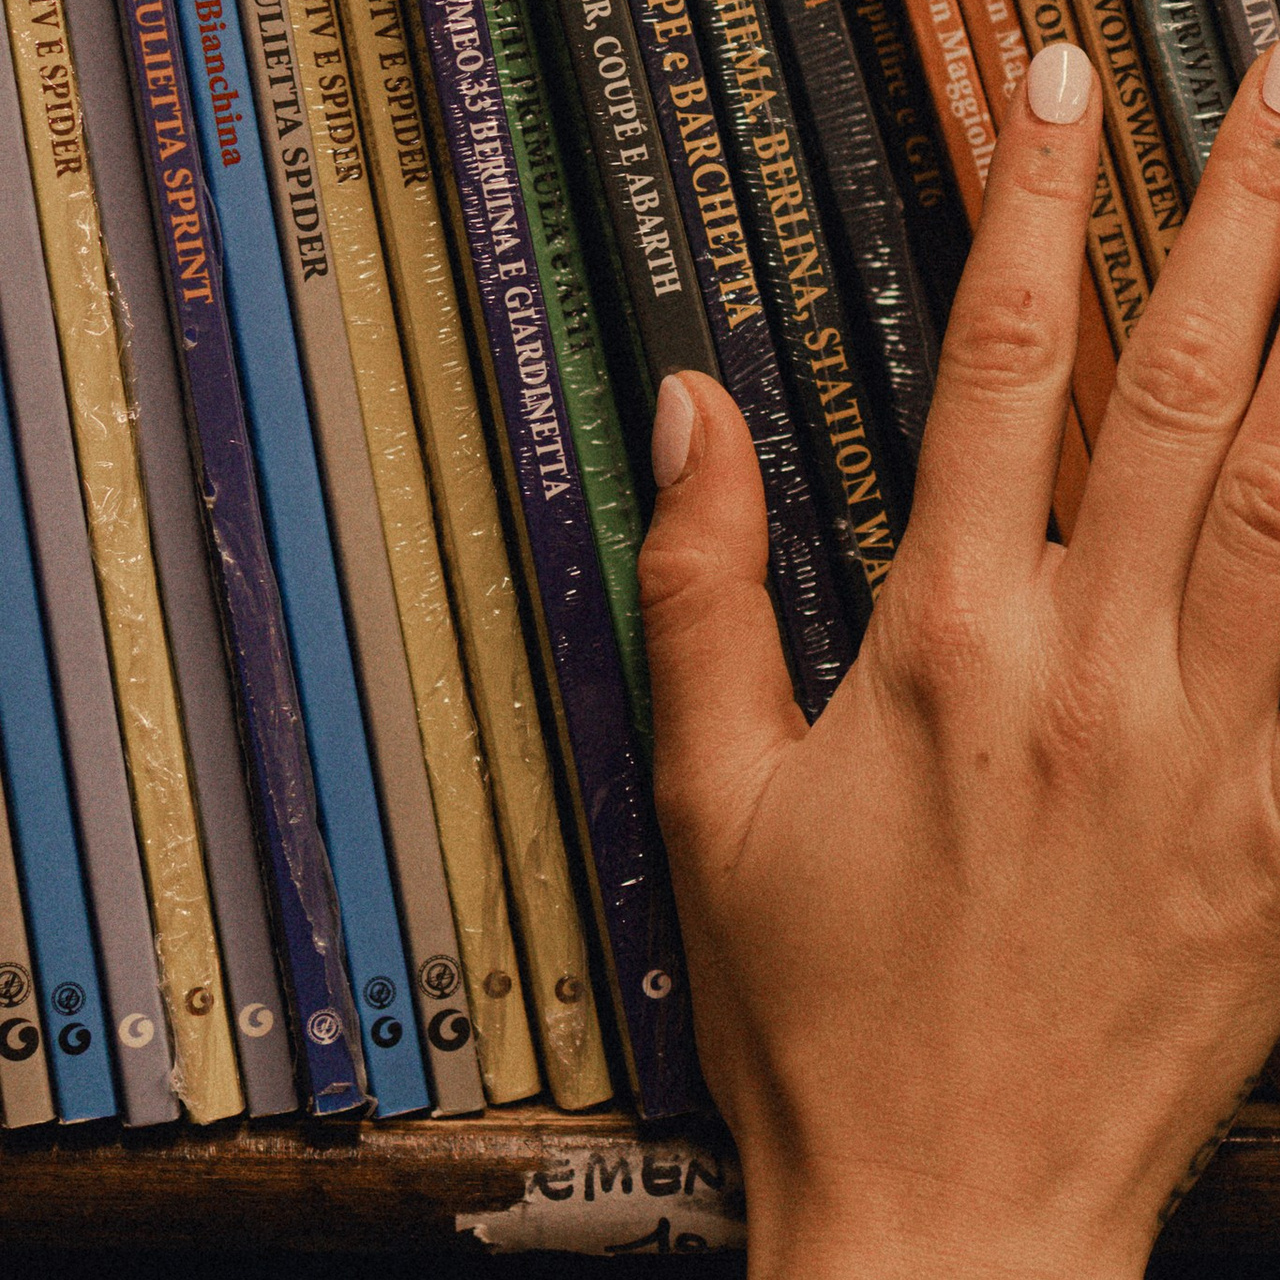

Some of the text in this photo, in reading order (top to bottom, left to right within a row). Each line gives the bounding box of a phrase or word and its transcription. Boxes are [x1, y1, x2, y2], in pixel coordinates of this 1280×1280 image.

[36, 37, 52, 57] E
[314, 49, 341, 71] E
[380, 51, 403, 73] E
[463, 75, 491, 112] 33
[593, 34, 642, 141] COUPÉ
[662, 53, 688, 73] e
[40, 64, 83, 179] SPIDER
[318, 74, 363, 187] SPIDER
[383, 78, 428, 190] SPIDER
[618, 149, 649, 167] E
[160, 166, 214, 306] SPRINT
[281, 146, 329, 283] SPIDER
[470, 120, 517, 252] BERLINA
[627, 172, 682, 296] ABARTH
[669, 79, 762, 329] BARCHETTA
[495, 260, 527, 281] E
[1098, 223, 1143, 338] TRAN
[504, 288, 570, 502] GIARDINETTA
[753, 129, 825, 322] BERLINA,
[803, 326, 881, 506] STATION
[853, 511, 894, 603] WA
